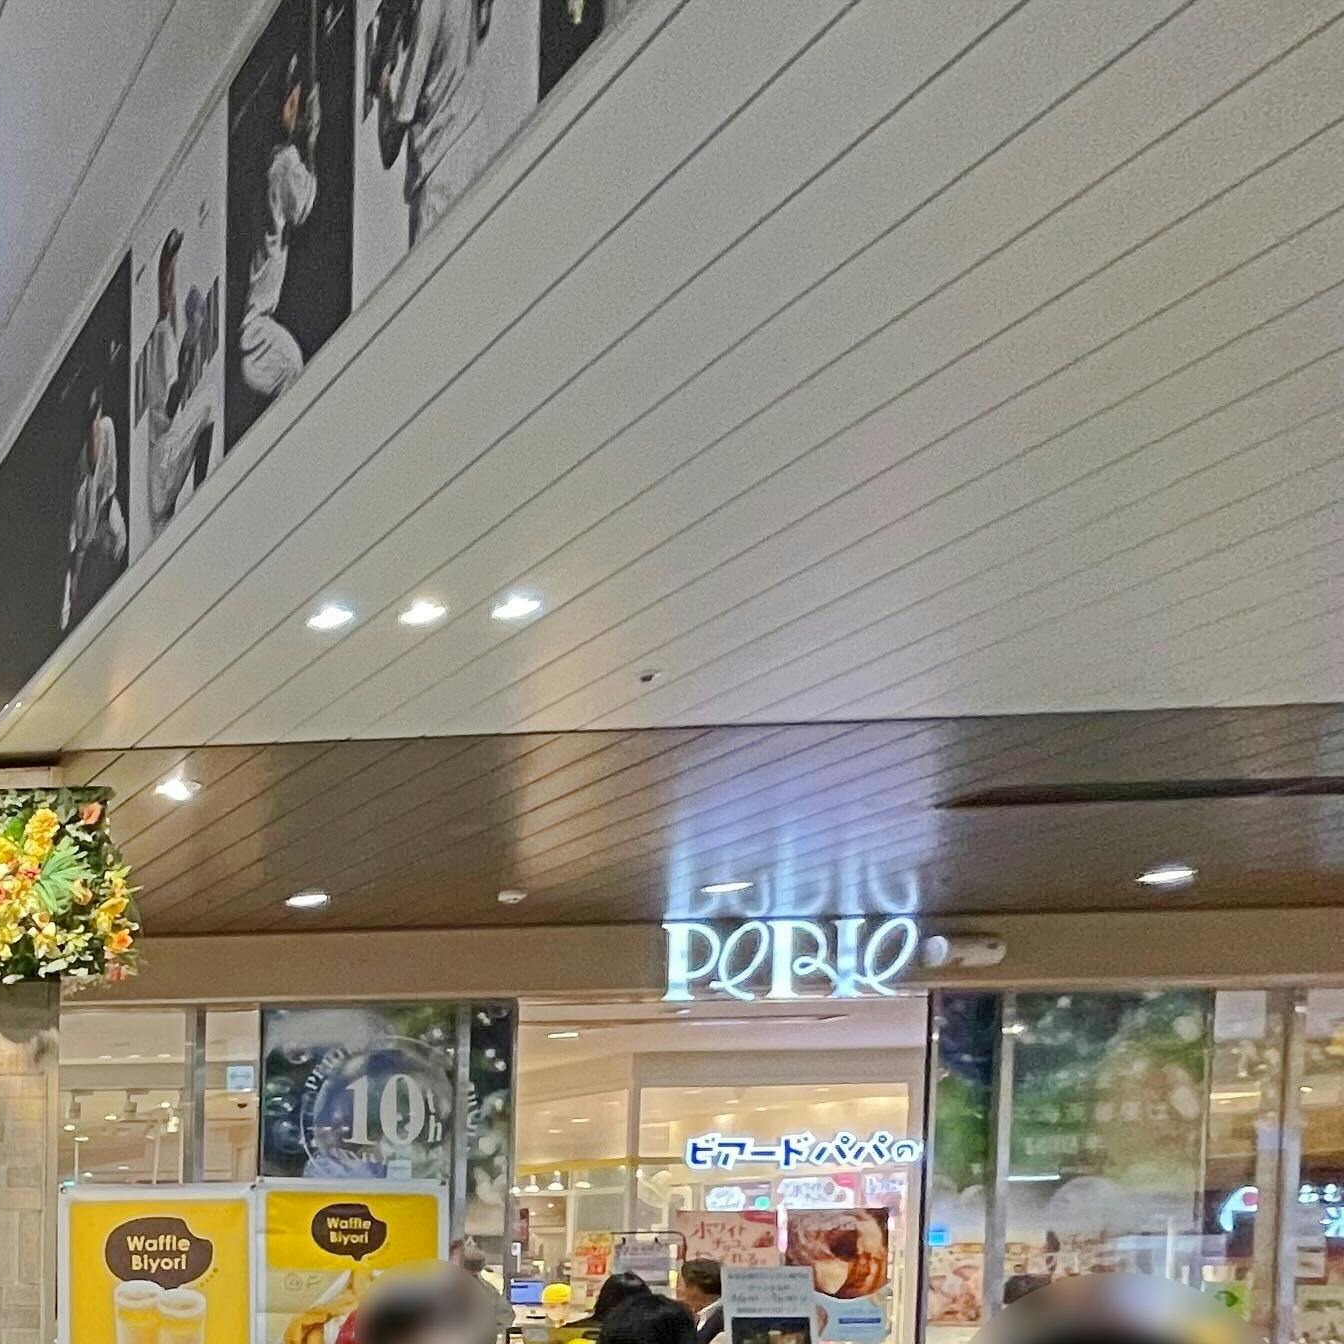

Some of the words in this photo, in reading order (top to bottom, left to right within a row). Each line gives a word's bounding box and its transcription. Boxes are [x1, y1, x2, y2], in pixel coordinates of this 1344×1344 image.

[687, 1132, 921, 1169] ビアードパパの
[327, 1217, 371, 1230] Waffle
[127, 1234, 191, 1251] Waffle
[330, 1231, 369, 1245] Biyori
[131, 1254, 187, 1273] Biyori
